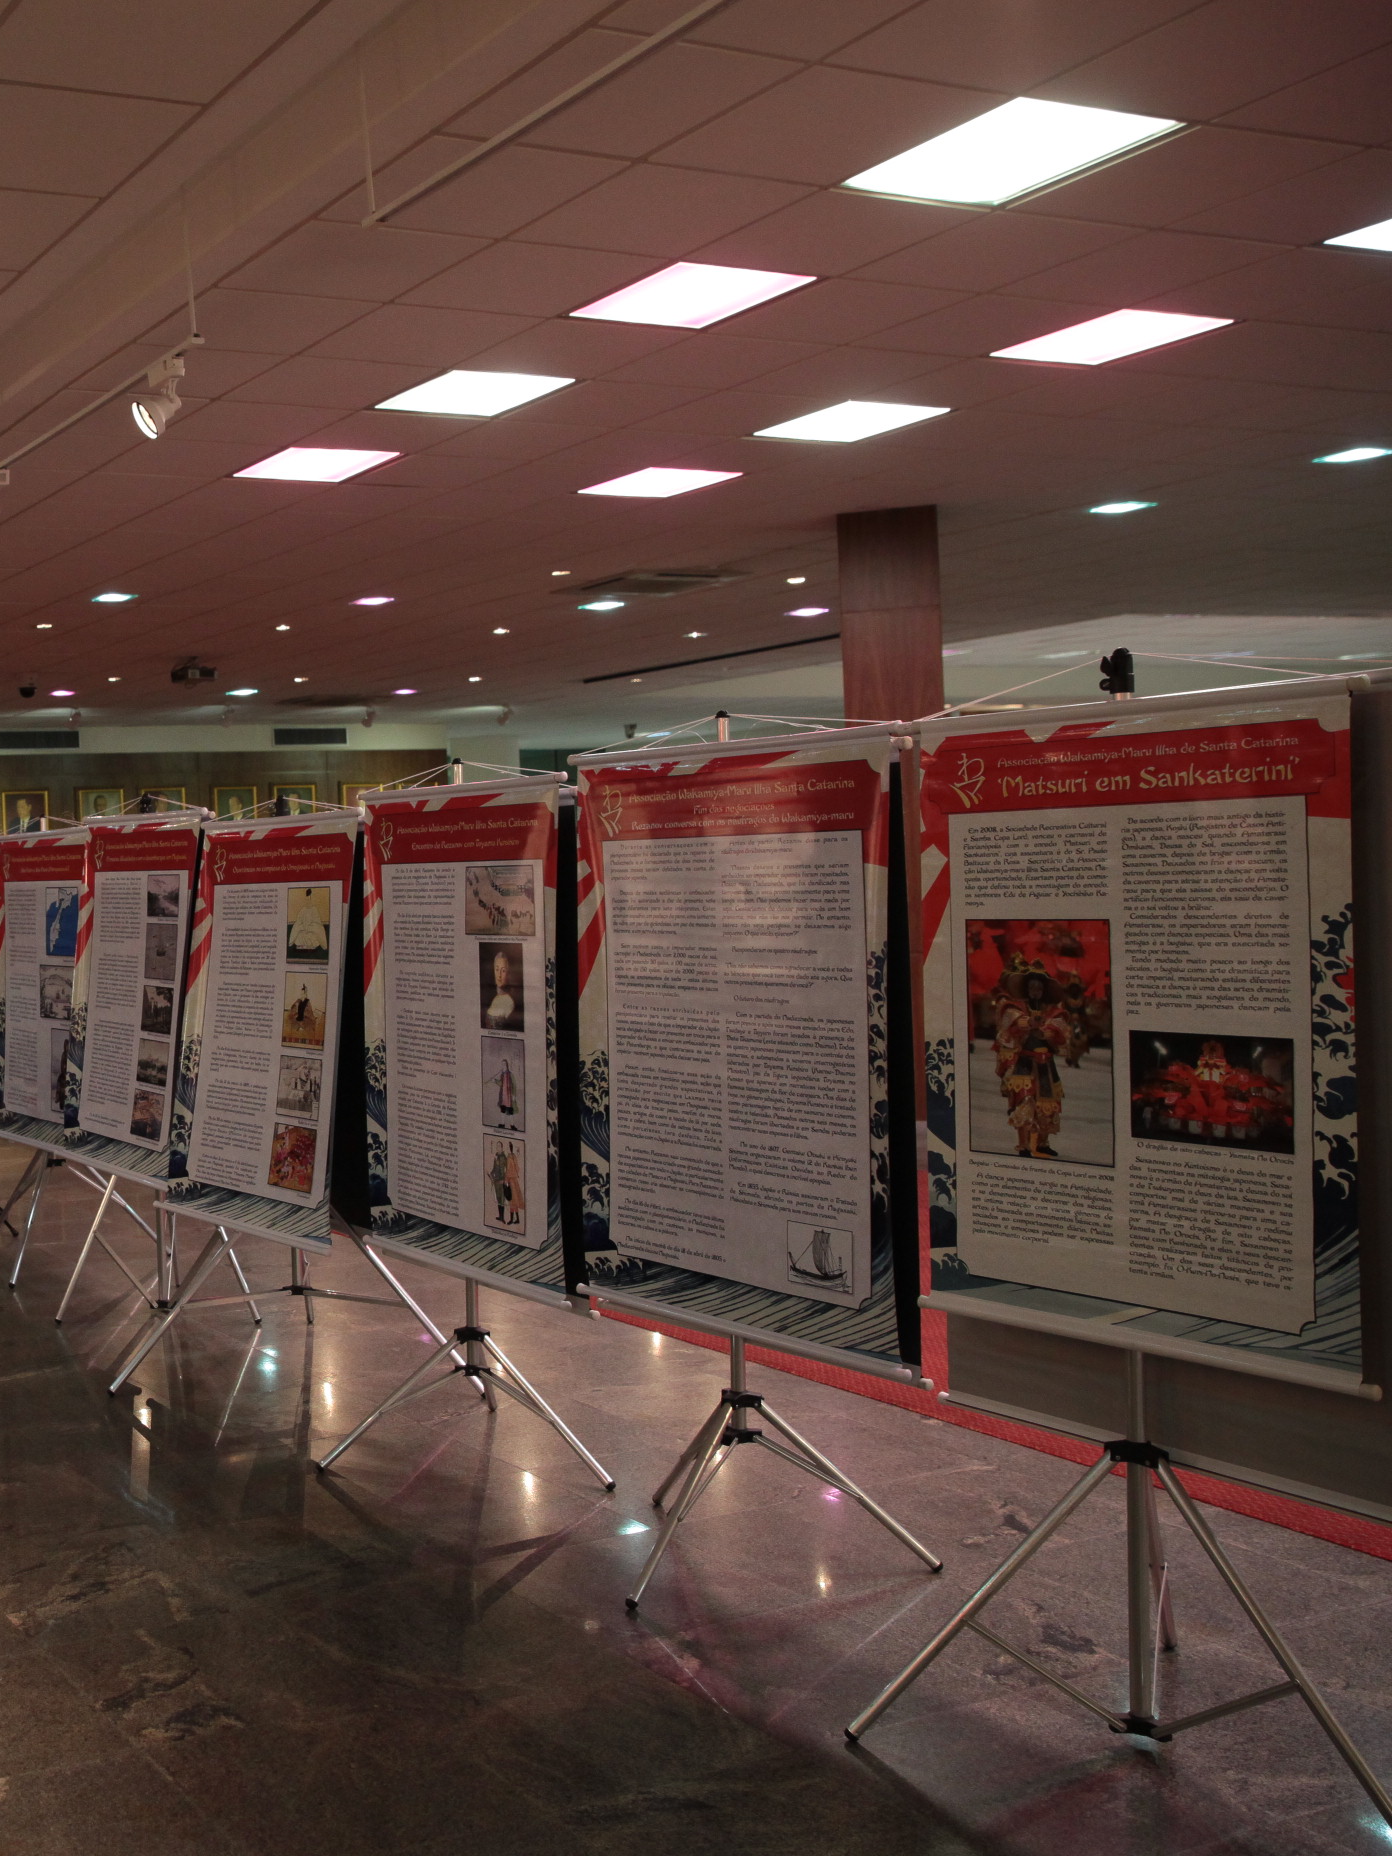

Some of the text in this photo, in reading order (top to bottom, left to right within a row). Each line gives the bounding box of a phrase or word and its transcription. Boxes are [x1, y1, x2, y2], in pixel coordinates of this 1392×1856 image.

[1060, 747, 1153, 766] Wakamiya-Maru
[1155, 743, 1177, 756] Ilha
[1181, 742, 1196, 754] de
[1199, 739, 1237, 753] Santa
[1241, 735, 1299, 749] Catarina
[678, 786, 752, 801] Wakamiya-Maru
[774, 782, 804, 793] Santa
[807, 777, 855, 791] Catarina
[1095, 774, 1131, 792] em
[488, 819, 507, 828] Santa
[508, 818, 538, 828] Catarina
[698, 819, 715, 827] com
[781, 811, 855, 825] Wakamiya-maru
